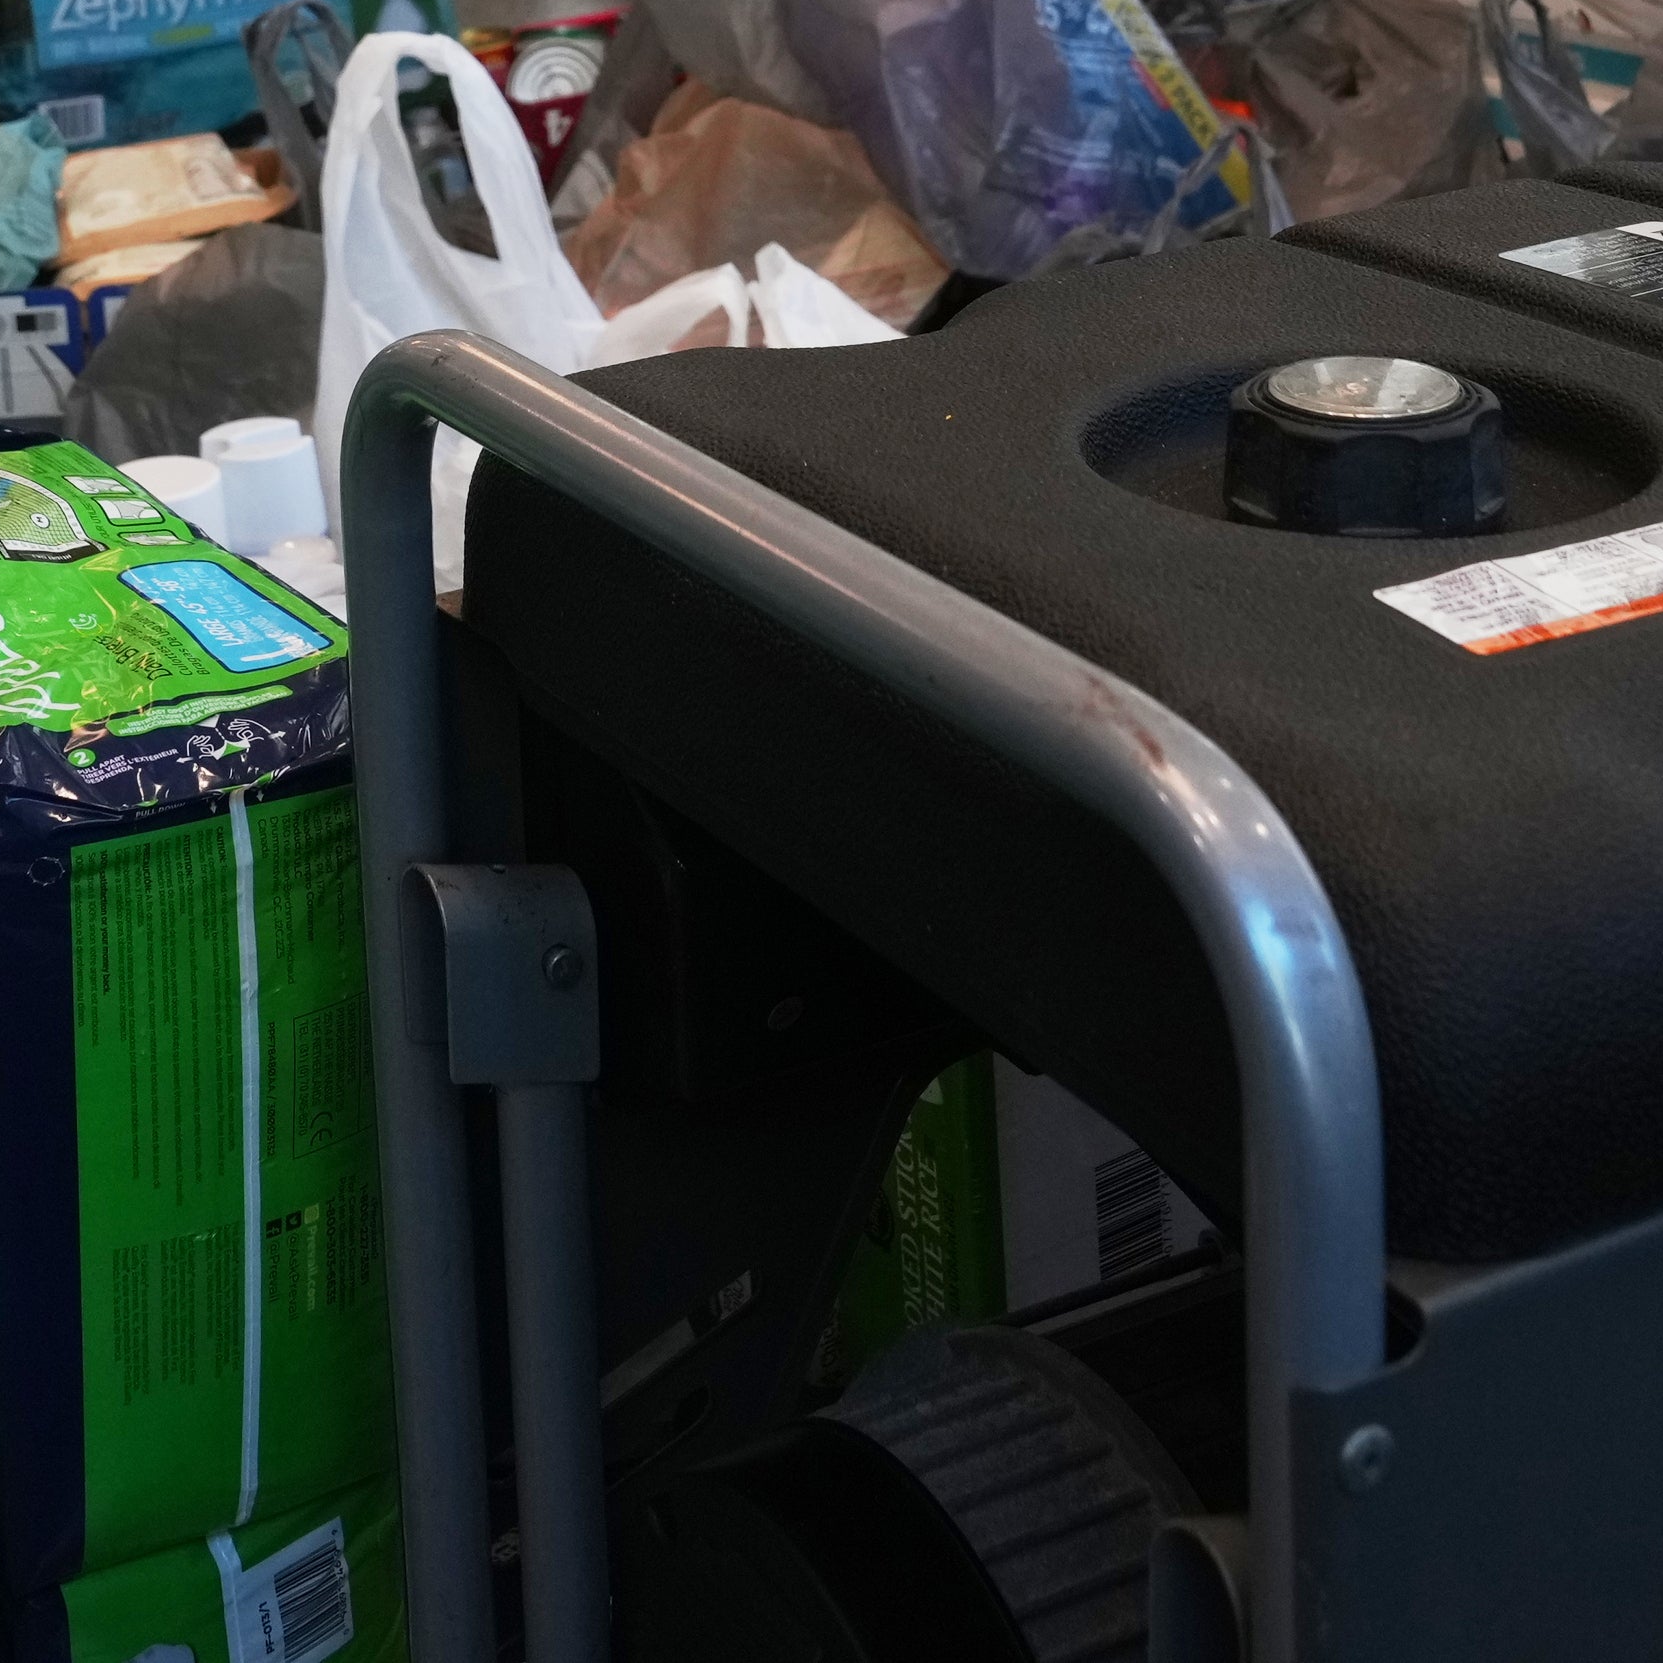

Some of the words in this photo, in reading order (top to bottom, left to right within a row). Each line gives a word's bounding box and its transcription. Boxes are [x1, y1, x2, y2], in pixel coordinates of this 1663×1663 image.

[198, 618, 245, 647] LARGE
[73, 752, 89, 764] 2
[85, 766, 133, 784] DESPRENDA
[99, 755, 125, 768] APART
[107, 763, 126, 773] VERS
[183, 834, 192, 879] ATTENTION:
[216, 825, 227, 863] CAUTION:
[256, 818, 269, 859] Canada
[143, 843, 152, 893] PRECAUCIÓN:
[101, 946, 109, 973] money
[918, 1151, 940, 1235] RICE
[267, 1240, 281, 1302] @Prevail
[286, 1232, 300, 1322] @AskPrevail
[306, 1225, 319, 1312] Prevail.com
[259, 1601, 275, 1654] PF-013/1
